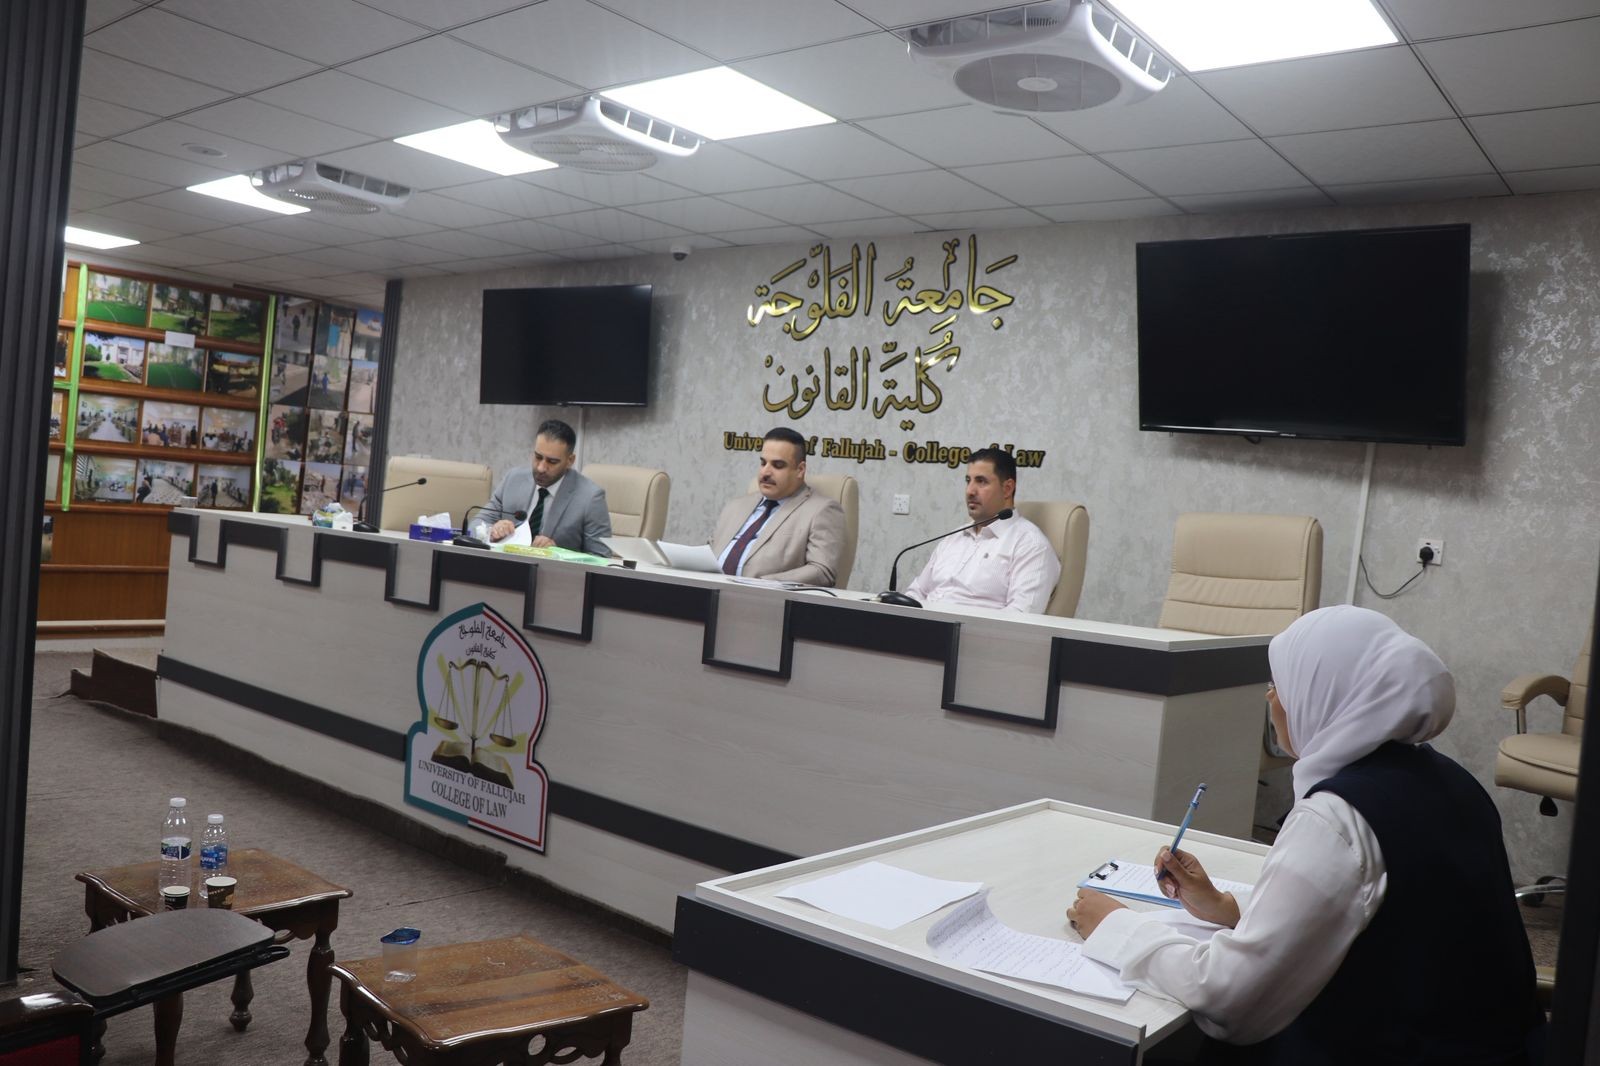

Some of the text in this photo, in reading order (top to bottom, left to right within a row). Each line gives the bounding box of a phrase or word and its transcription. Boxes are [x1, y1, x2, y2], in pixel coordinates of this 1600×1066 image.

[821, 438, 886, 463] Fallujah
[902, 441, 972, 468] College
[418, 759, 526, 805] UNIVERSITY OF FALLUJAH
[431, 780, 508, 818] COLLEGE OF LAW
